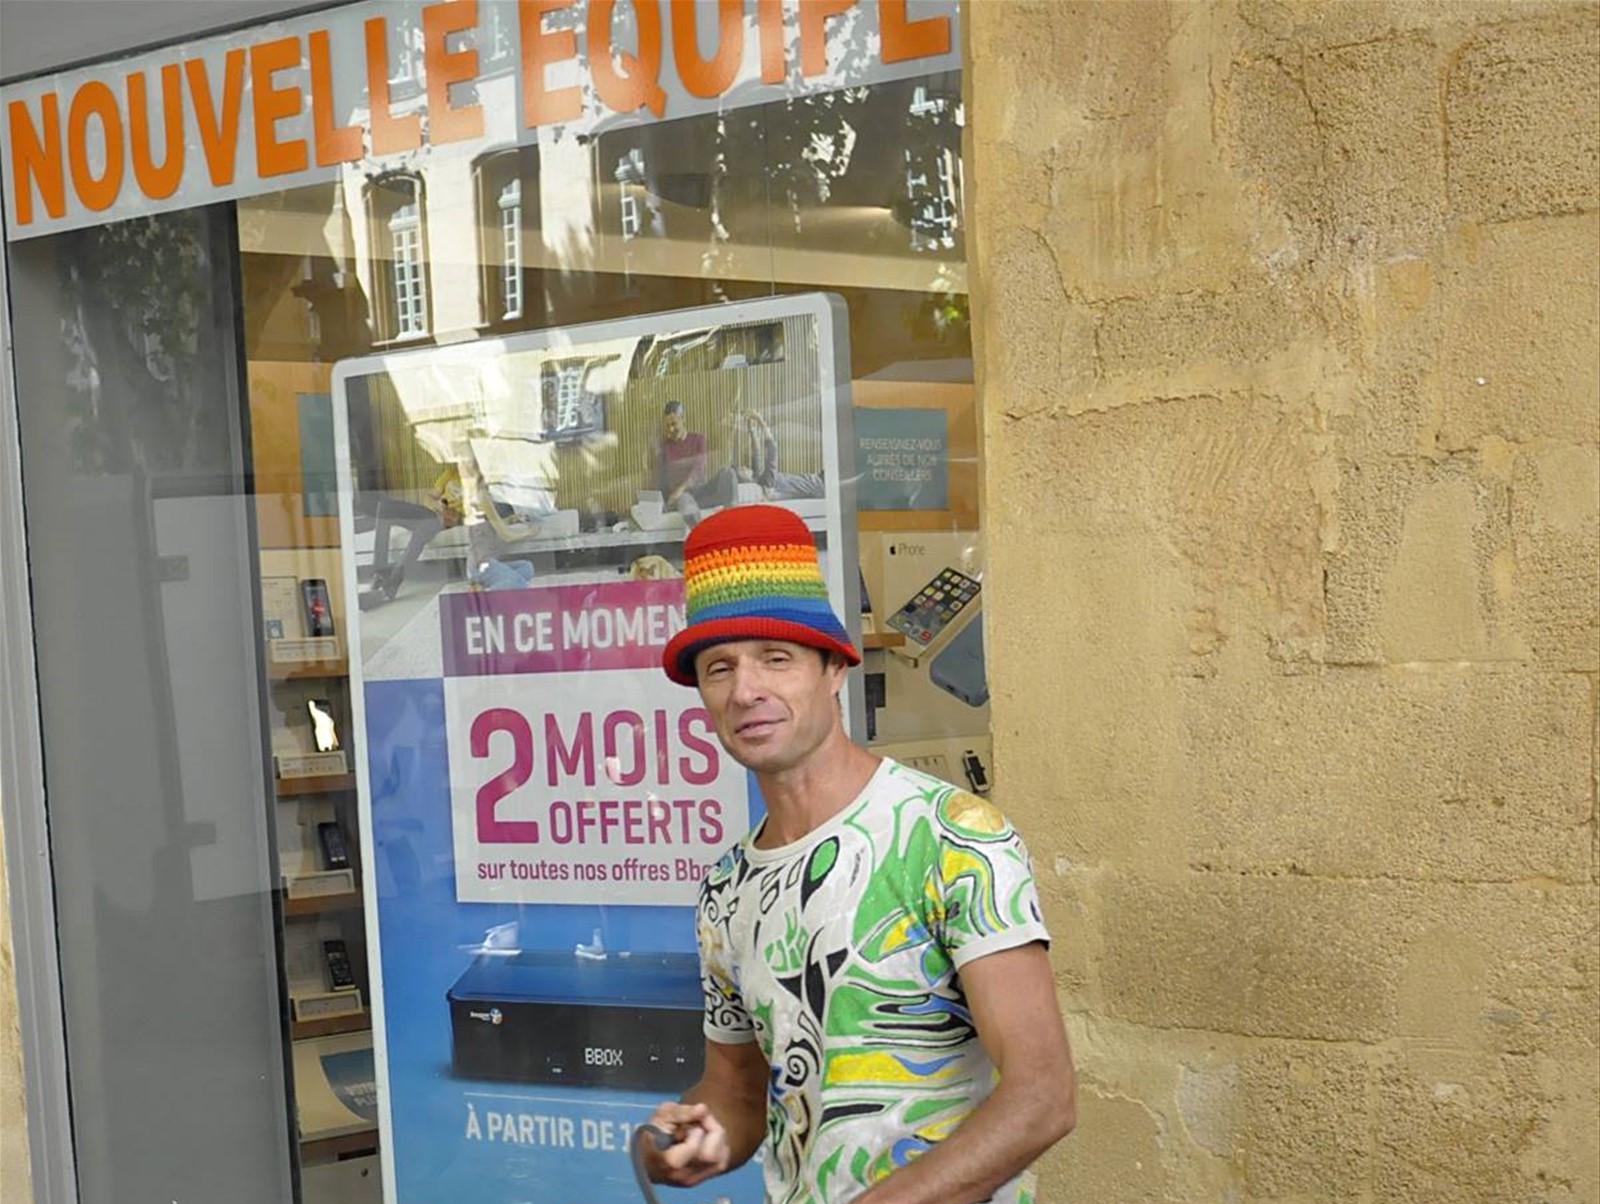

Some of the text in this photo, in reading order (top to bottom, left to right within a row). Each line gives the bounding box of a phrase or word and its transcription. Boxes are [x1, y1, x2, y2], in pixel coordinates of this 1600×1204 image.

[8, 0, 487, 226] NOUVELLE
[465, 603, 687, 655] EN CE MOMEN
[470, 707, 720, 843] 2 MOIS
[549, 799, 724, 845] OFFERTS
[477, 862, 510, 880] sur
[510, 859, 569, 881] toutes
[574, 863, 607, 881] nos
[611, 858, 671, 882] offres
[584, 1047, 624, 1067] BBOX
[465, 1103, 482, 1140] À
[487, 1111, 575, 1148] PARTIR
[581, 1118, 616, 1151] DE
